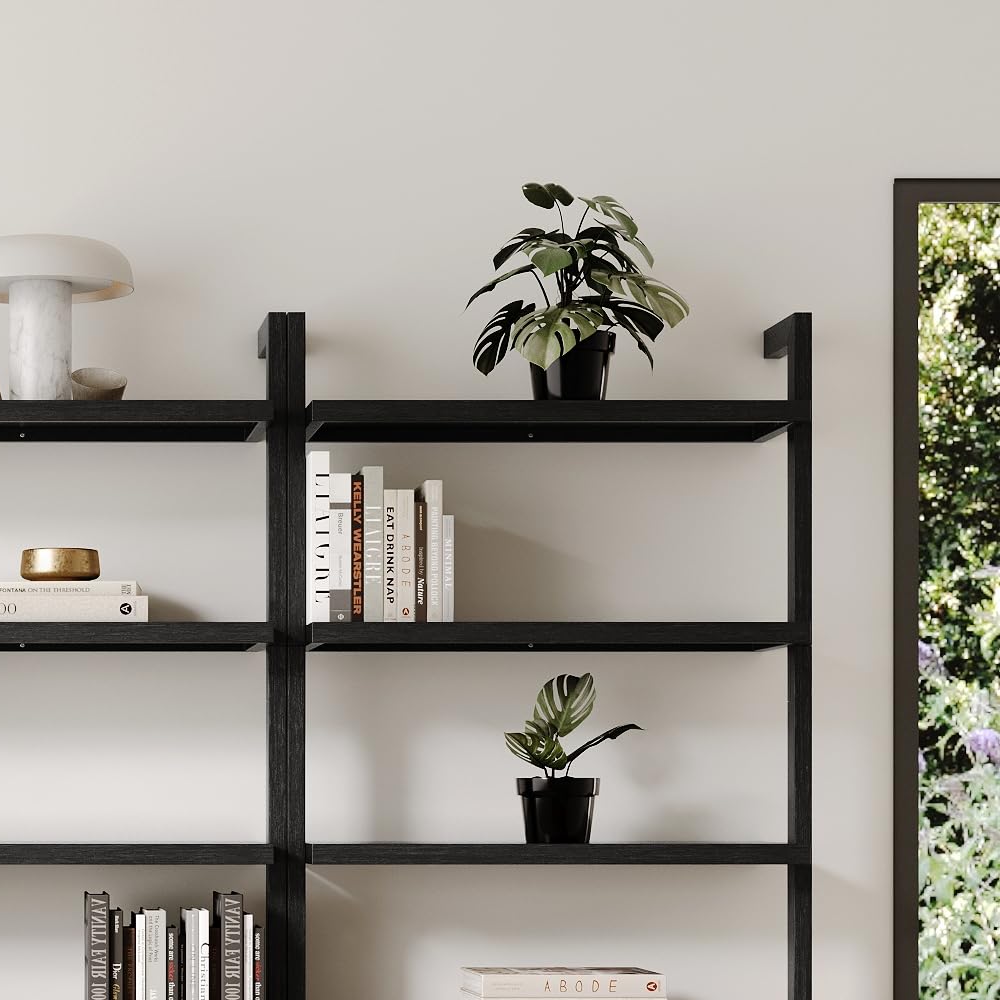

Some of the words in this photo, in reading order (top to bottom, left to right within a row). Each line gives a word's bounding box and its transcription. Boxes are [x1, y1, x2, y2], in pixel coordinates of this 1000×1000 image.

[353, 482, 362, 524] KELLY
[386, 506, 394, 530] EAT
[365, 506, 381, 584] LIAIGRE
[386, 534, 394, 574] DRINK
[353, 528, 362, 614] WEARSTLER
[386, 578, 394, 604] NAP
[113, 963, 122, 980] Dior
[544, 980, 618, 992] ABODE
